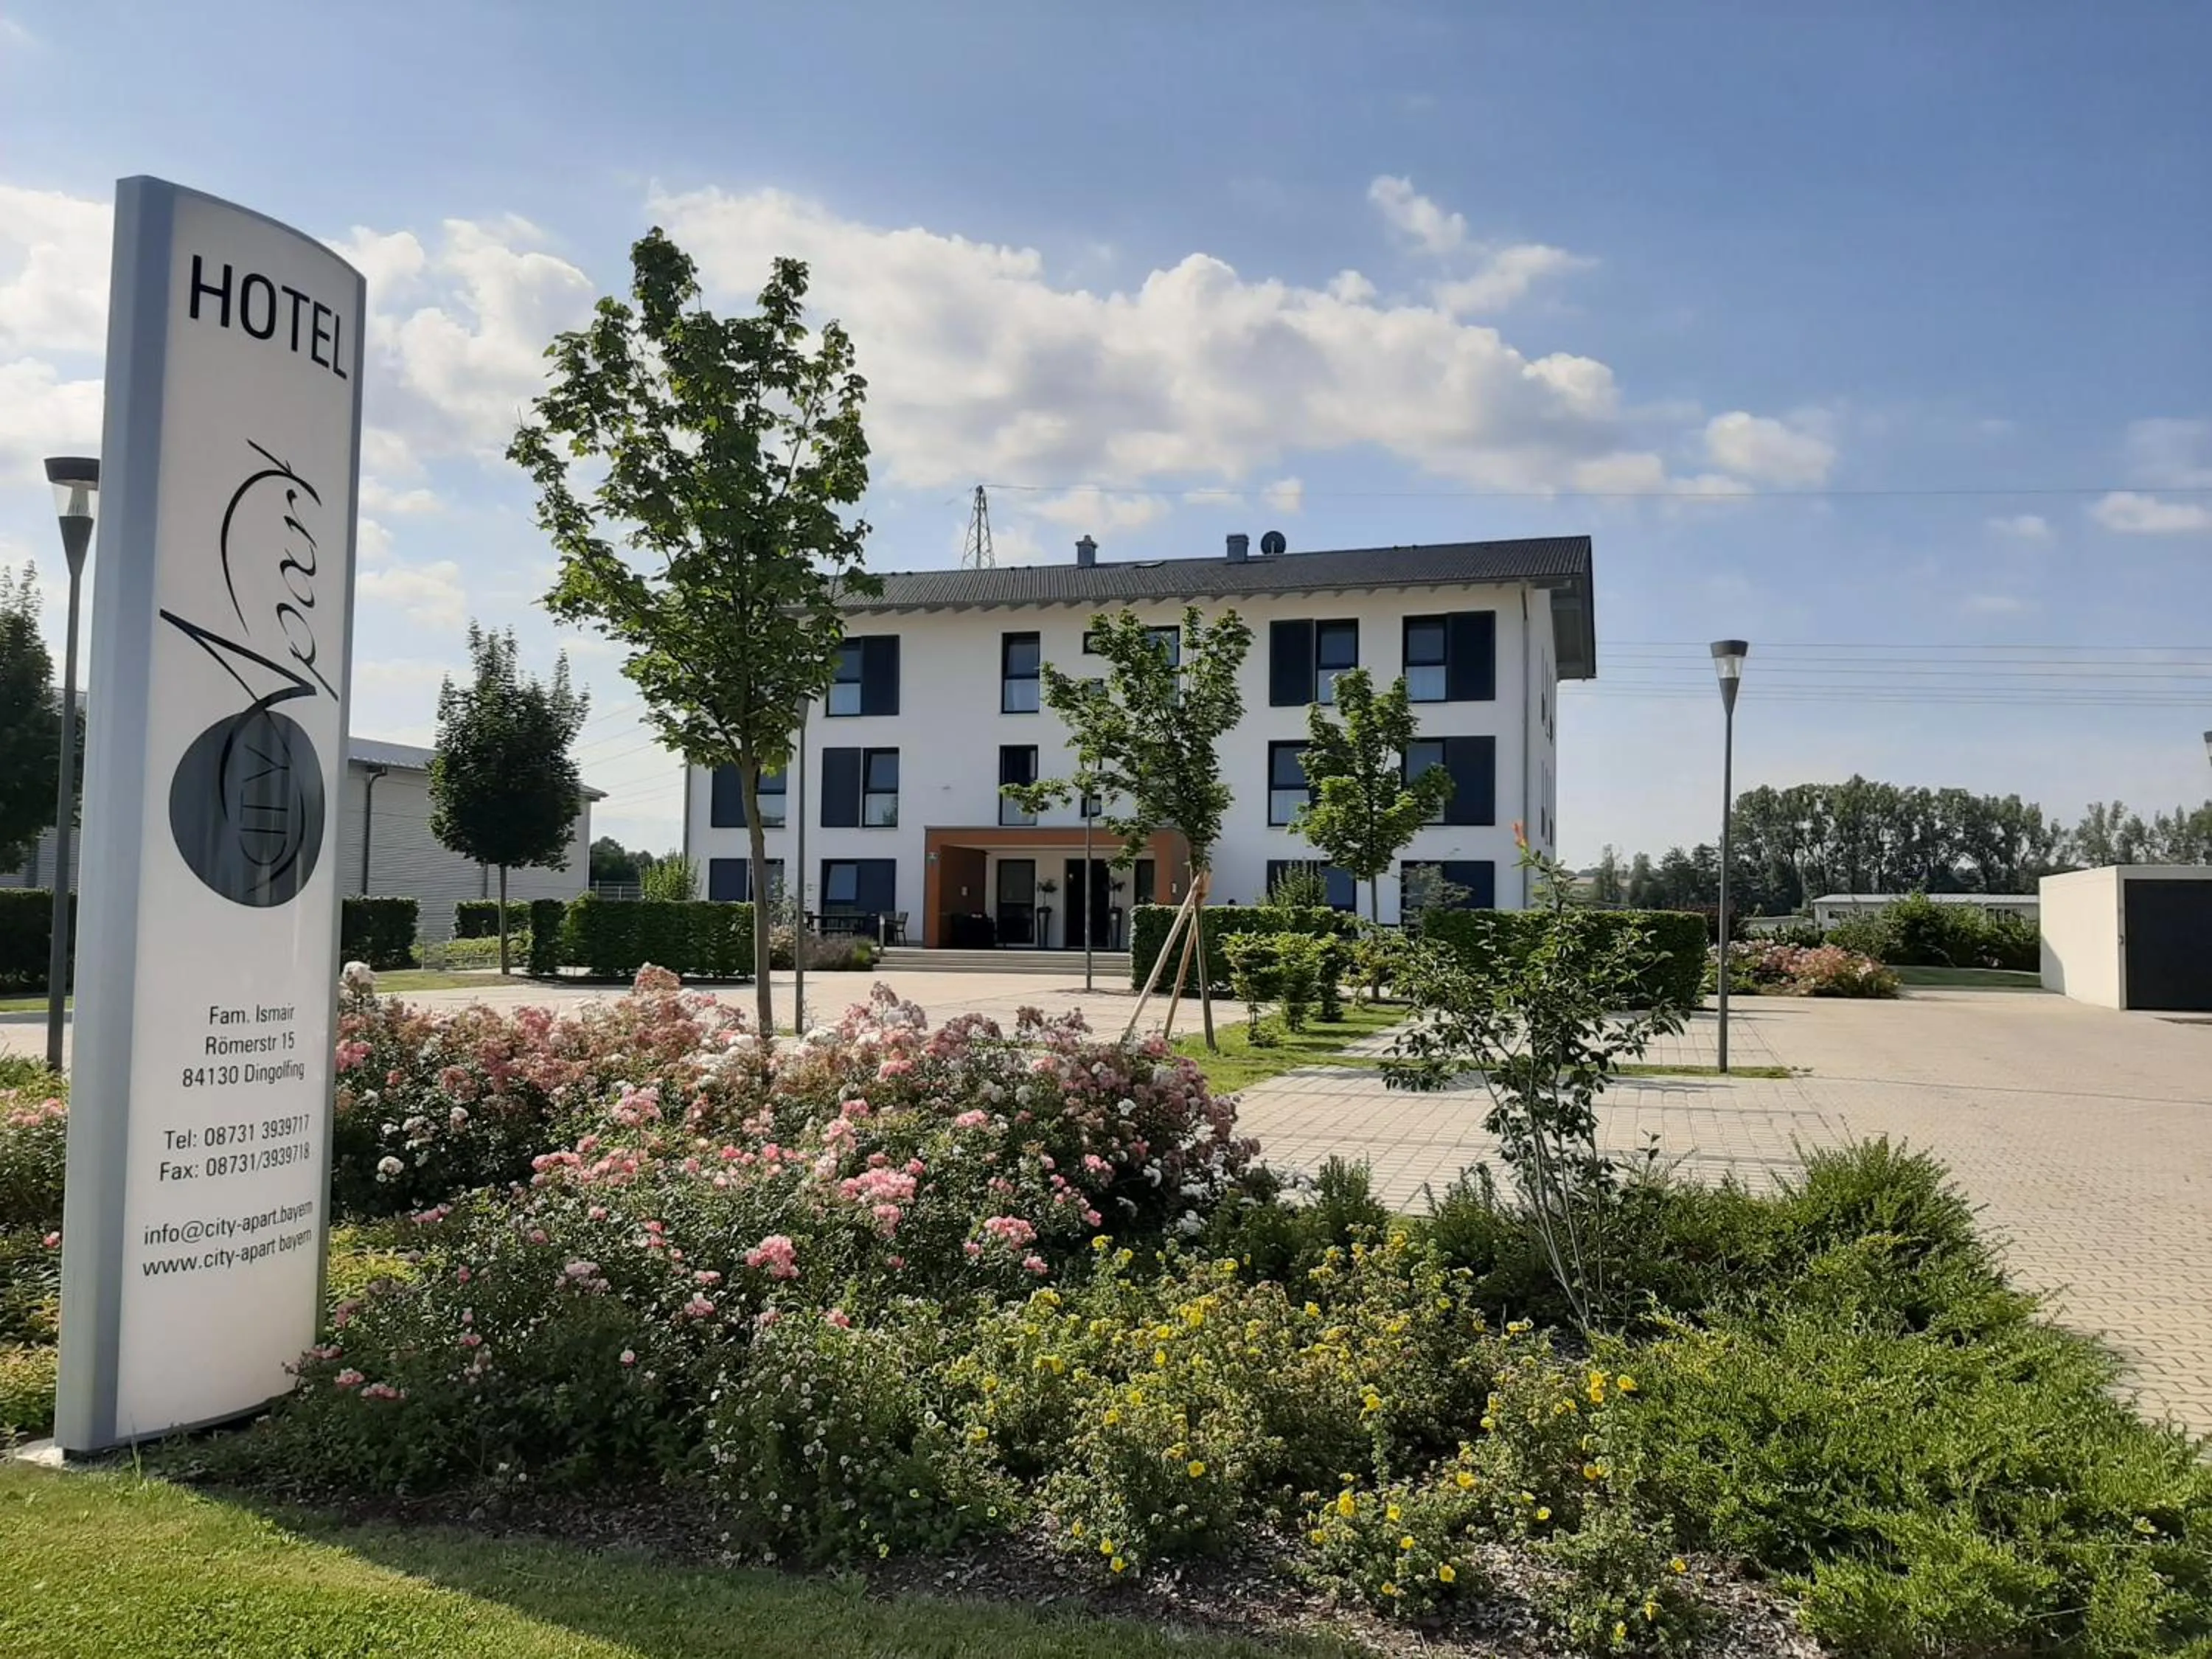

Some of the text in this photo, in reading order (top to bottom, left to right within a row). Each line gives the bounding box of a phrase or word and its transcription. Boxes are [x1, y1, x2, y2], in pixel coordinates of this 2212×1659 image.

[189, 254, 348, 380] HOTEL
[210, 1004, 295, 1025] Fam. Ismair
[282, 1032, 295, 1050] 15
[182, 1060, 305, 1088] 84130 Dingolfing
[164, 1114, 310, 1150] Tel: 08731 3939717
[159, 1142, 310, 1181] Fax: 08731/3939718
[144, 1201, 313, 1245] info@city-apart.bayern
